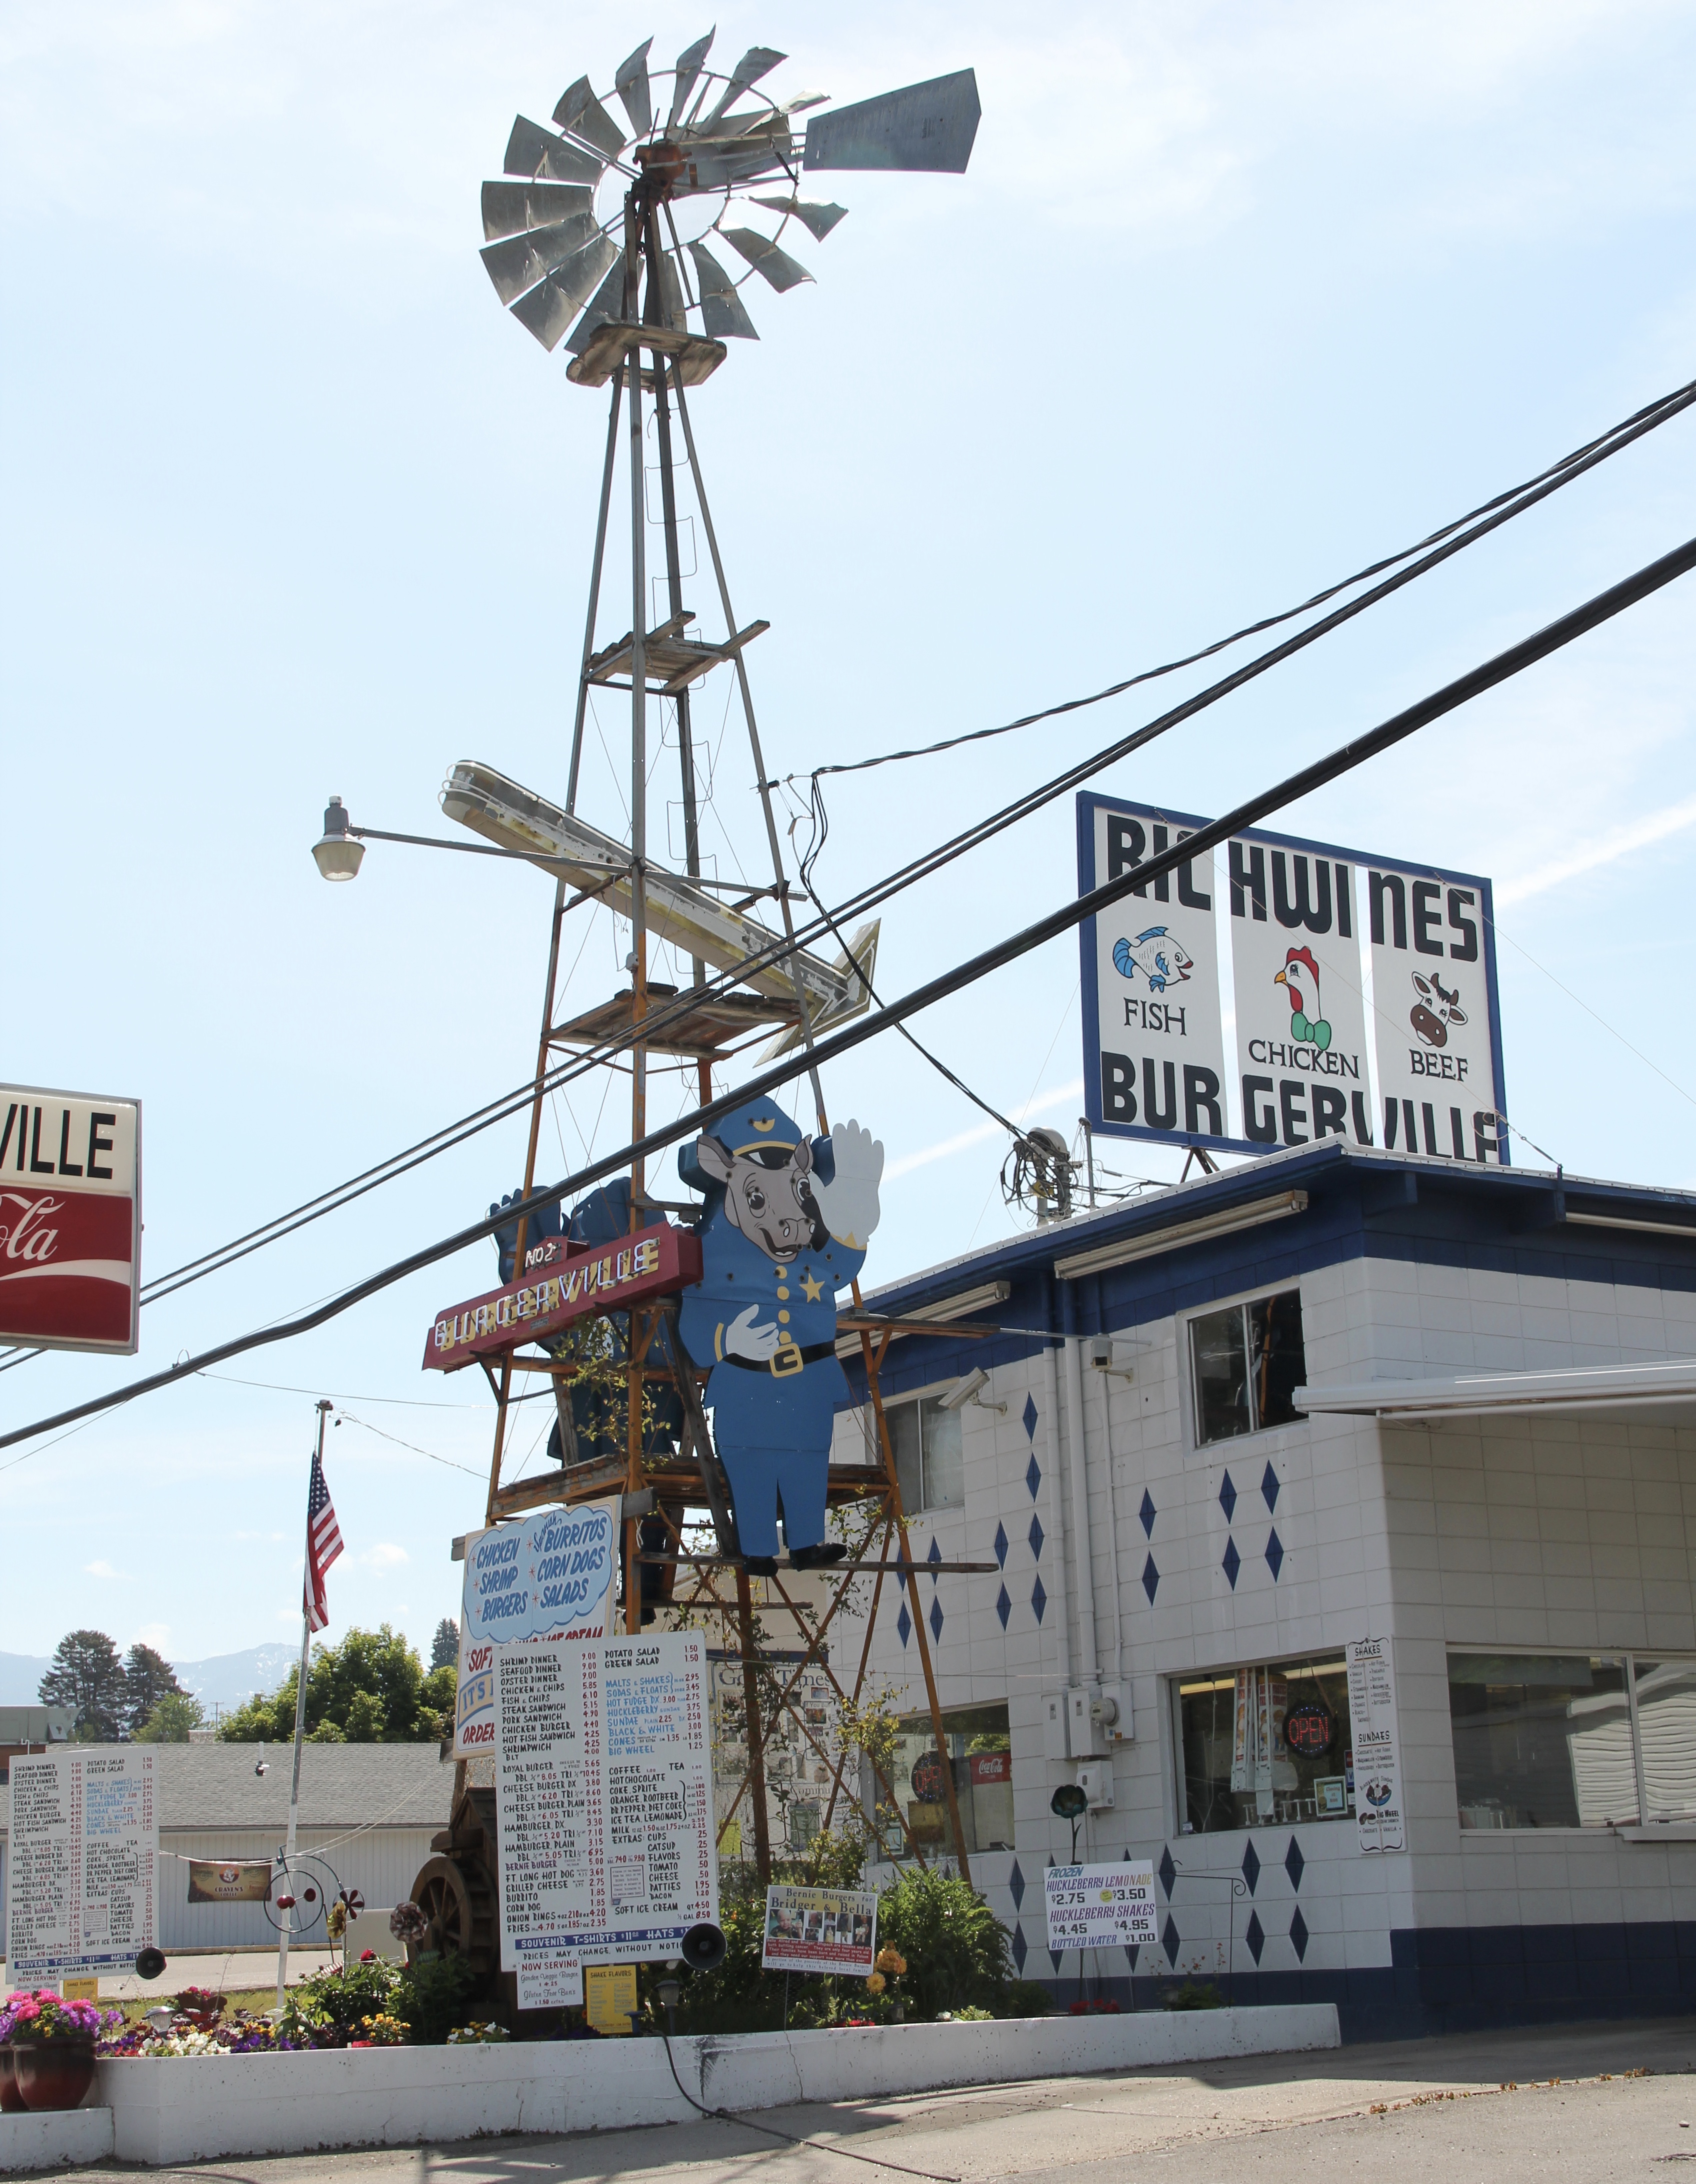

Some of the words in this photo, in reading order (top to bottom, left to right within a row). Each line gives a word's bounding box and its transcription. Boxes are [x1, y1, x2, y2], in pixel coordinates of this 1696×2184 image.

[1124, 997, 1187, 1036] FISH
[1249, 1040, 1361, 1080] CHICKEN
[1410, 1050, 1469, 1082] BEEF
[435, 1237, 660, 1352] BURGERVILLE
[544, 1516, 607, 1552] BURRITOS
[477, 1538, 521, 1569] CHICKEN
[537, 1552, 571, 1582] CORN
[570, 1546, 606, 1575] DOGS
[479, 1566, 518, 1595] SHRIMP
[540, 1578, 589, 1608] SALADS
[481, 1591, 528, 1622] BURGERS
[605, 1649, 633, 1658] POTATO
[637, 1647, 660, 1656] SALAD
[1355, 1644, 1381, 1656] SHAKES
[500, 1656, 528, 1666] SHRIMP
[530, 1654, 558, 1664] DINNER
[582, 1652, 596, 1660] 9.00
[605, 1659, 632, 1668] GREEN
[636, 1656, 659, 1666] SALAD
[500, 1666, 533, 1676] SEAFOOD
[535, 1664, 562, 1673] DINNER
[501, 1676, 528, 1686] OYSTER
[531, 1674, 558, 1684] DINNER
[606, 1679, 631, 1688] MALTS
[640, 1675, 670, 1685] SHAKES
[463, 1678, 485, 1712] IT'S
[501, 1686, 534, 1695] CHICKEN
[543, 1683, 565, 1692] CHIPS
[607, 1688, 631, 1698] SODAS
[640, 1685, 668, 1694] FLOATS
[502, 1706, 527, 1714] STEAK
[528, 1702, 566, 1713] SANDWICH
[607, 1705, 658, 1716] HUCKLEBERRY
[686, 1702, 700, 1711] 3.75
[502, 1716, 520, 1724] PORK
[524, 1712, 562, 1723] SANDWICH
[583, 1710, 598, 1718] 4.90
[502, 1724, 536, 1734] CHICKEN
[540, 1721, 570, 1732] BURGER
[608, 1727, 635, 1737] BLACK
[639, 1726, 645, 1734] &
[648, 1724, 675, 1734] WHITE
[1289, 1716, 1329, 1744] OPEN
[1359, 1730, 1390, 1742] SUNDAES
[502, 1742, 551, 1754] SHRIMPWICH
[608, 1747, 622, 1756] BIG
[625, 1745, 655, 1754] WHEEL
[502, 1765, 524, 1774] ROYAL
[525, 1762, 554, 1772] BURGER
[609, 1766, 640, 1775] COFFEE
[669, 1762, 684, 1770] TEA
[625, 1774, 665, 1784] CHOCOLATE
[643, 1792, 678, 1802] ROOTBEER
[644, 1812, 683, 1822] LEMONADE
[612, 1826, 630, 1834] MILK
[648, 1832, 666, 1841] CUPS
[648, 1841, 675, 1852] CATSUP
[648, 1852, 680, 1862] FLAVORS
[505, 1862, 529, 1871] BERNIE
[531, 1860, 557, 1868] BURGER
[649, 1862, 678, 1872] TOMATO
[520, 1872, 539, 1881] LONG
[542, 1871, 557, 1880] HOT
[560, 1870, 575, 1878] DOG
[649, 1872, 679, 1882] CHEESE
[1048, 1866, 1084, 1878] FROZEN
[506, 1882, 534, 1893] GRILLED
[537, 1880, 568, 1890] CHEESE
[649, 1882, 681, 1892] PATTIES
[1047, 1877, 1103, 1892] HUCKLEBERRY
[1105, 1874, 1152, 1887] LEMONADE
[506, 1892, 538, 1902] BURRITO
[786, 1888, 816, 1898] Bernie
[822, 1890, 855, 1902] Burgers
[1052, 1892, 1085, 1905] $2.75
[1113, 1888, 1146, 1900] $3.50
[615, 1906, 634, 1915] SOFT
[637, 1904, 649, 1913] ICE
[653, 1902, 678, 1912] CREAM
[771, 1897, 816, 1910] Bridger
[840, 1902, 871, 1914] Bella
[507, 1914, 529, 1923] ONION
[532, 1912, 556, 1920] RINGS
[1050, 1906, 1115, 1922] HUCKLEBERRY
[1117, 1903, 1155, 1917] SHAKES
[507, 1924, 530, 1933] FRIES
[1053, 1923, 1087, 1935] $4.45
[1115, 1919, 1148, 1930] $4.95
[521, 1936, 566, 1948] SOUVENIR
[646, 1928, 674, 1939] HATS
[1052, 1936, 1086, 1949] BOTTLED
[1088, 1934, 1117, 1946] WATER
[1126, 1933, 1155, 1942] $1.00
[523, 1952, 549, 1960] PRICES
[556, 1950, 571, 1958] MAY
[616, 1944, 652, 1953] WITHOUT
[18, 1960, 49, 1968] SOUVENIR
[522, 1962, 542, 1972] NOW
[544, 1960, 578, 1970] SERVING
[521, 1974, 539, 1983] Garden
[523, 1990, 542, 2000] Gluten
